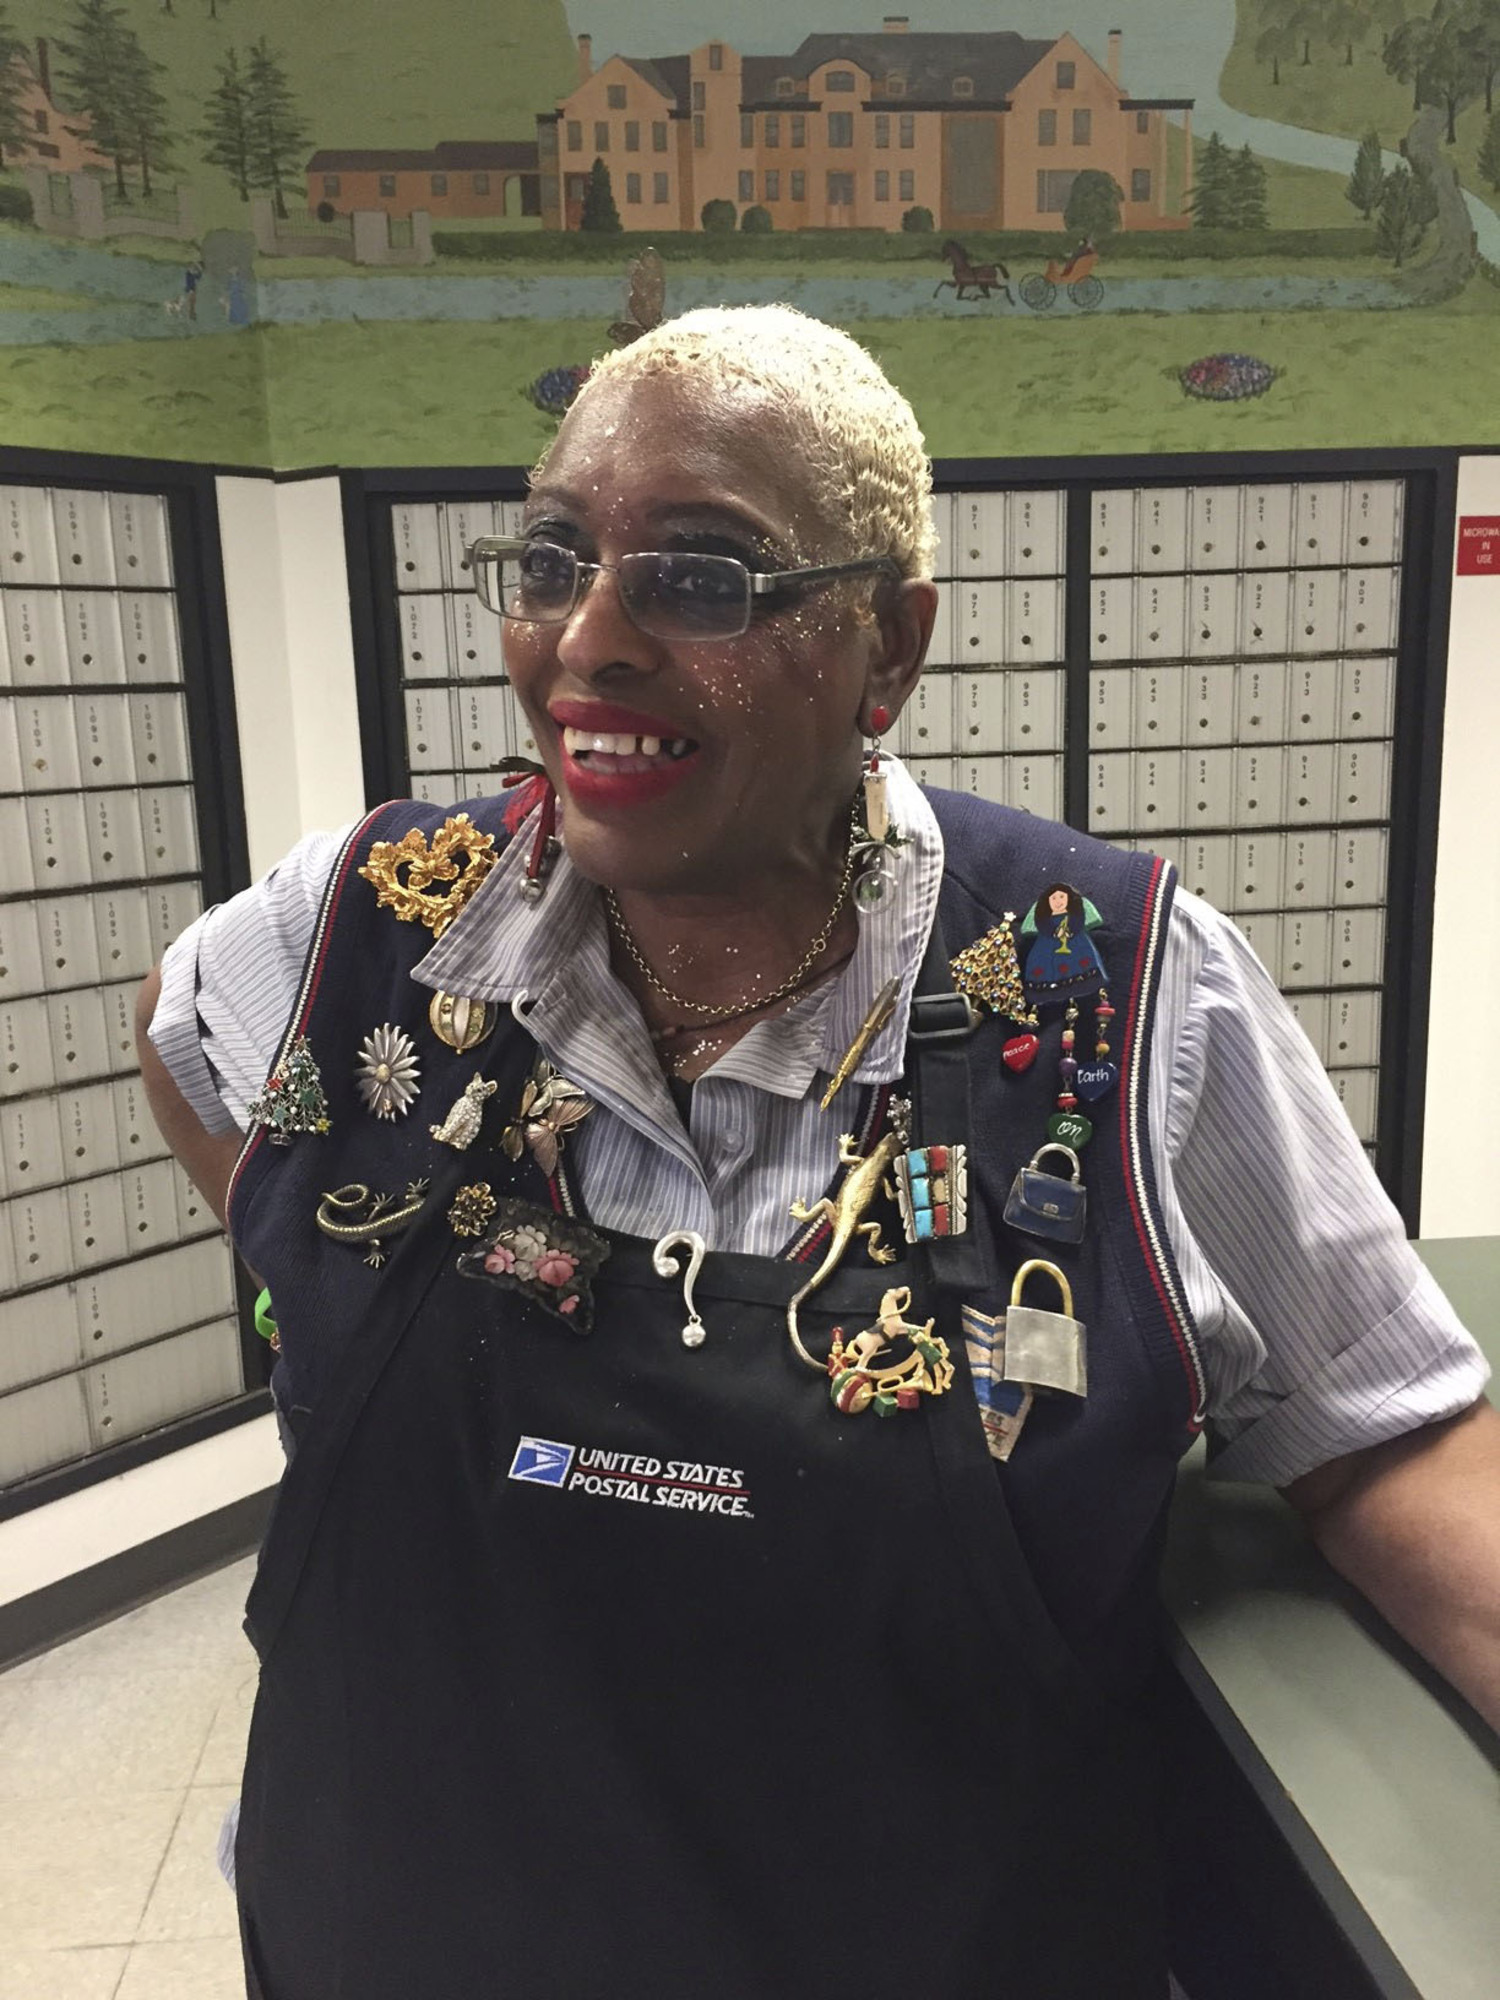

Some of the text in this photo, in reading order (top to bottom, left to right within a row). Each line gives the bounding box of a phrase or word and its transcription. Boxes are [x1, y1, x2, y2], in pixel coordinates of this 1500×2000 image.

[1023, 502, 1032, 527] 961
[1153, 500, 1161, 525] 941
[1205, 498, 1213, 523] 931
[1257, 496, 1266, 522] 921
[1360, 492, 1370, 517] 901
[971, 504, 979, 530] 971
[1481, 541, 1491, 551] IN
[1476, 554, 1493, 565] USE
[1023, 591, 1031, 616] 962
[1099, 590, 1107, 615] 952
[1151, 588, 1159, 613] 942
[1202, 586, 1211, 611] 932
[1255, 584, 1263, 609] 922
[1307, 582, 1315, 607] 912
[1357, 580, 1366, 604] 902
[971, 593, 979, 618] 972
[1098, 680, 1106, 704] 953
[1149, 678, 1157, 702] 943
[1200, 676, 1208, 700] 933
[1252, 674, 1260, 698] 923
[1303, 671, 1312, 696] 913
[1353, 669, 1362, 694] 903
[918, 684, 927, 709] 983
[971, 683, 979, 708] 973
[1022, 682, 1030, 706] 963
[1097, 764, 1105, 788] 954
[1148, 762, 1156, 786] 944
[1199, 760, 1207, 783] 934
[1250, 758, 1258, 781] 924
[1300, 756, 1308, 779] 914
[1349, 753, 1358, 777] 904
[970, 768, 979, 792] 974
[1022, 767, 1030, 790] 964
[1247, 844, 1255, 867] 925
[1297, 842, 1305, 866] 915
[1347, 840, 1356, 863] 905
[1294, 923, 1302, 945] 916
[1343, 920, 1352, 942] 906
[1340, 1002, 1349, 1025] 907
[1077, 1069, 1109, 1084] Earth
[578, 1447, 745, 1489] UNITED STATES
[568, 1472, 749, 1516] POSTAL SERVICE
